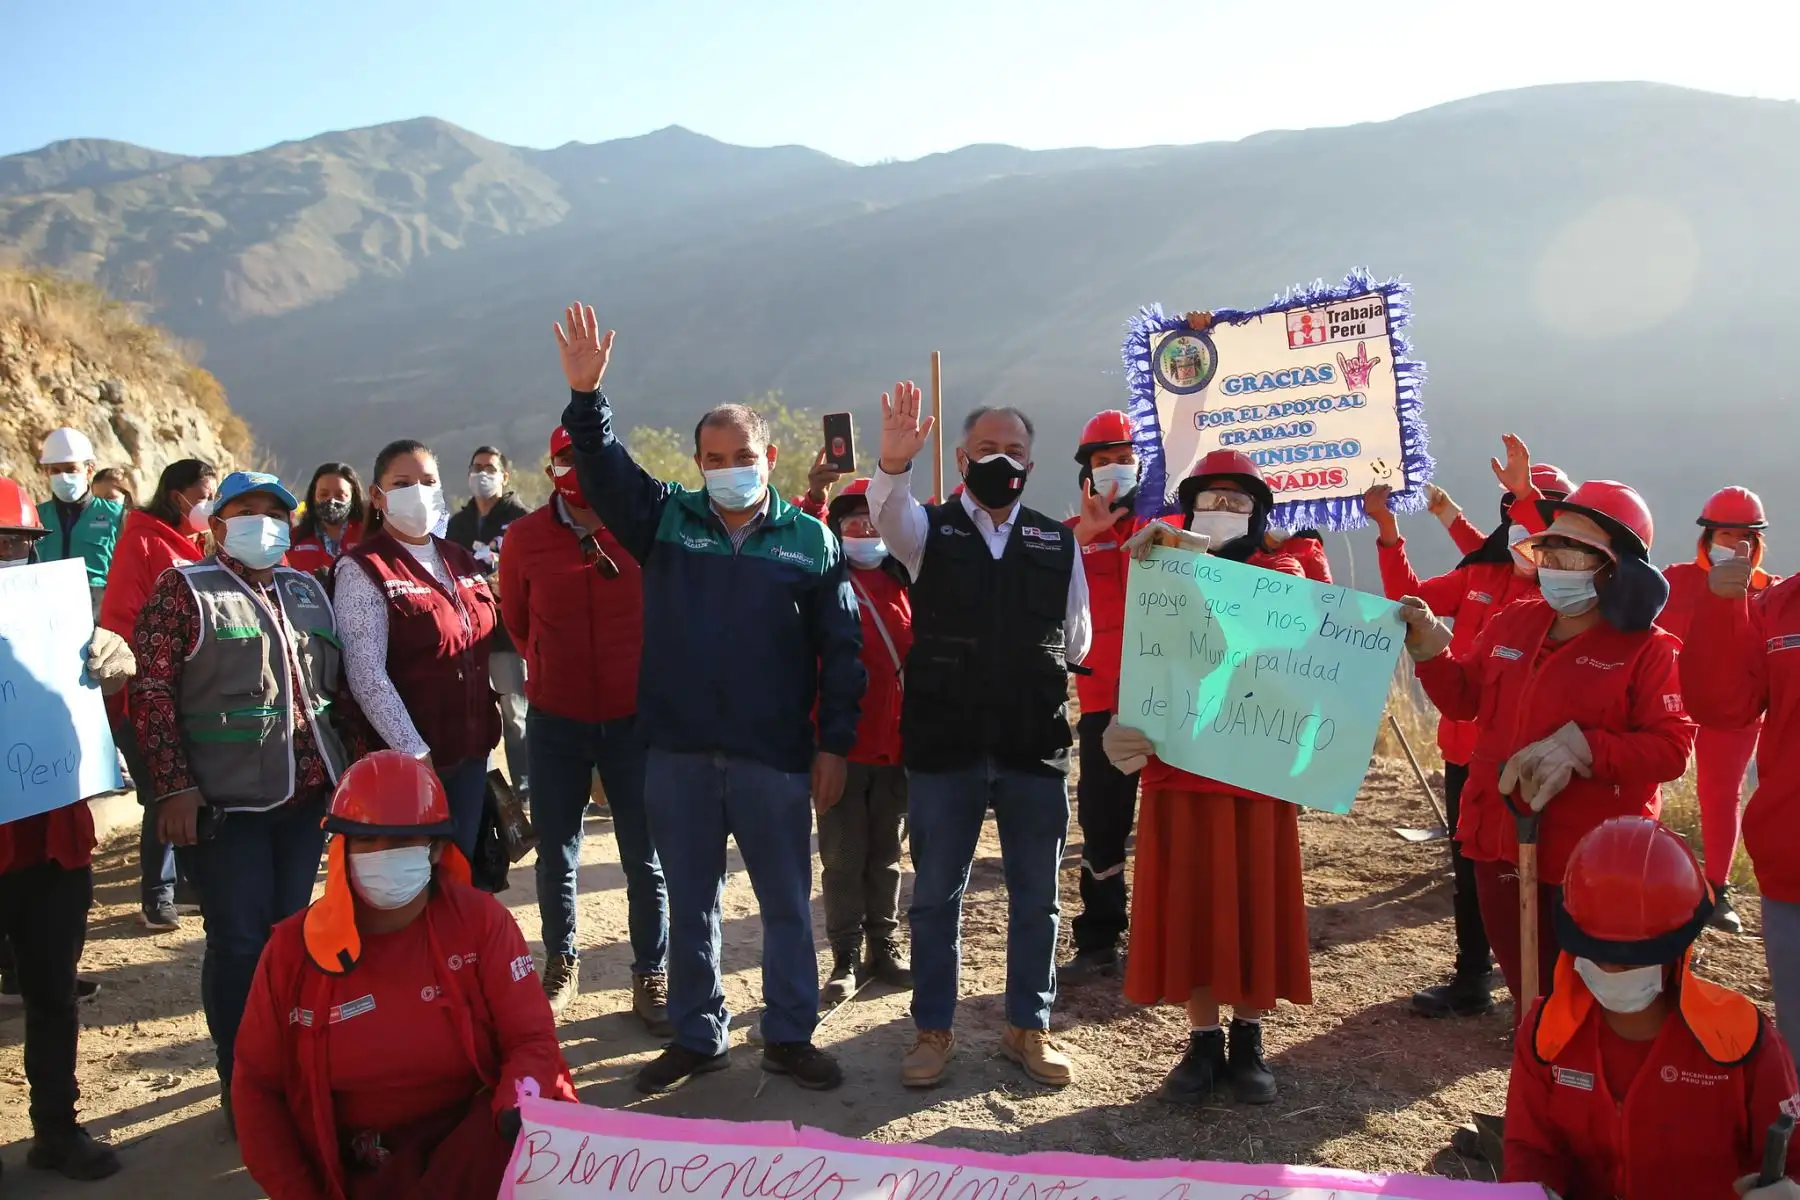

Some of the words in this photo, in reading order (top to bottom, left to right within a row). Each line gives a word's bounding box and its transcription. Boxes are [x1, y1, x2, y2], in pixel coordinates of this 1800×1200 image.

[1326, 304, 1383, 324] Trabaja
[1330, 321, 1366, 339] Perú
[1224, 365, 1334, 394] GRACIAS
[1197, 410, 1236, 428] POR
[1240, 408, 1263, 421] EL
[1267, 397, 1333, 419] APOYO
[1337, 394, 1365, 408] AL
[1221, 423, 1313, 446] TRABAJO
[1264, 469, 1343, 491] NADIS
[1252, 576, 1295, 599] por
[1321, 588, 1347, 609] el
[1139, 592, 1187, 616] apoyo
[1204, 598, 1241, 629] que
[1266, 608, 1307, 632] nos
[1319, 612, 1392, 653] brinda
[1139, 631, 1164, 657] La
[1189, 630, 1341, 684] Municipalidad
[1141, 686, 1168, 717] de
[7, 742, 76, 792] Perú
